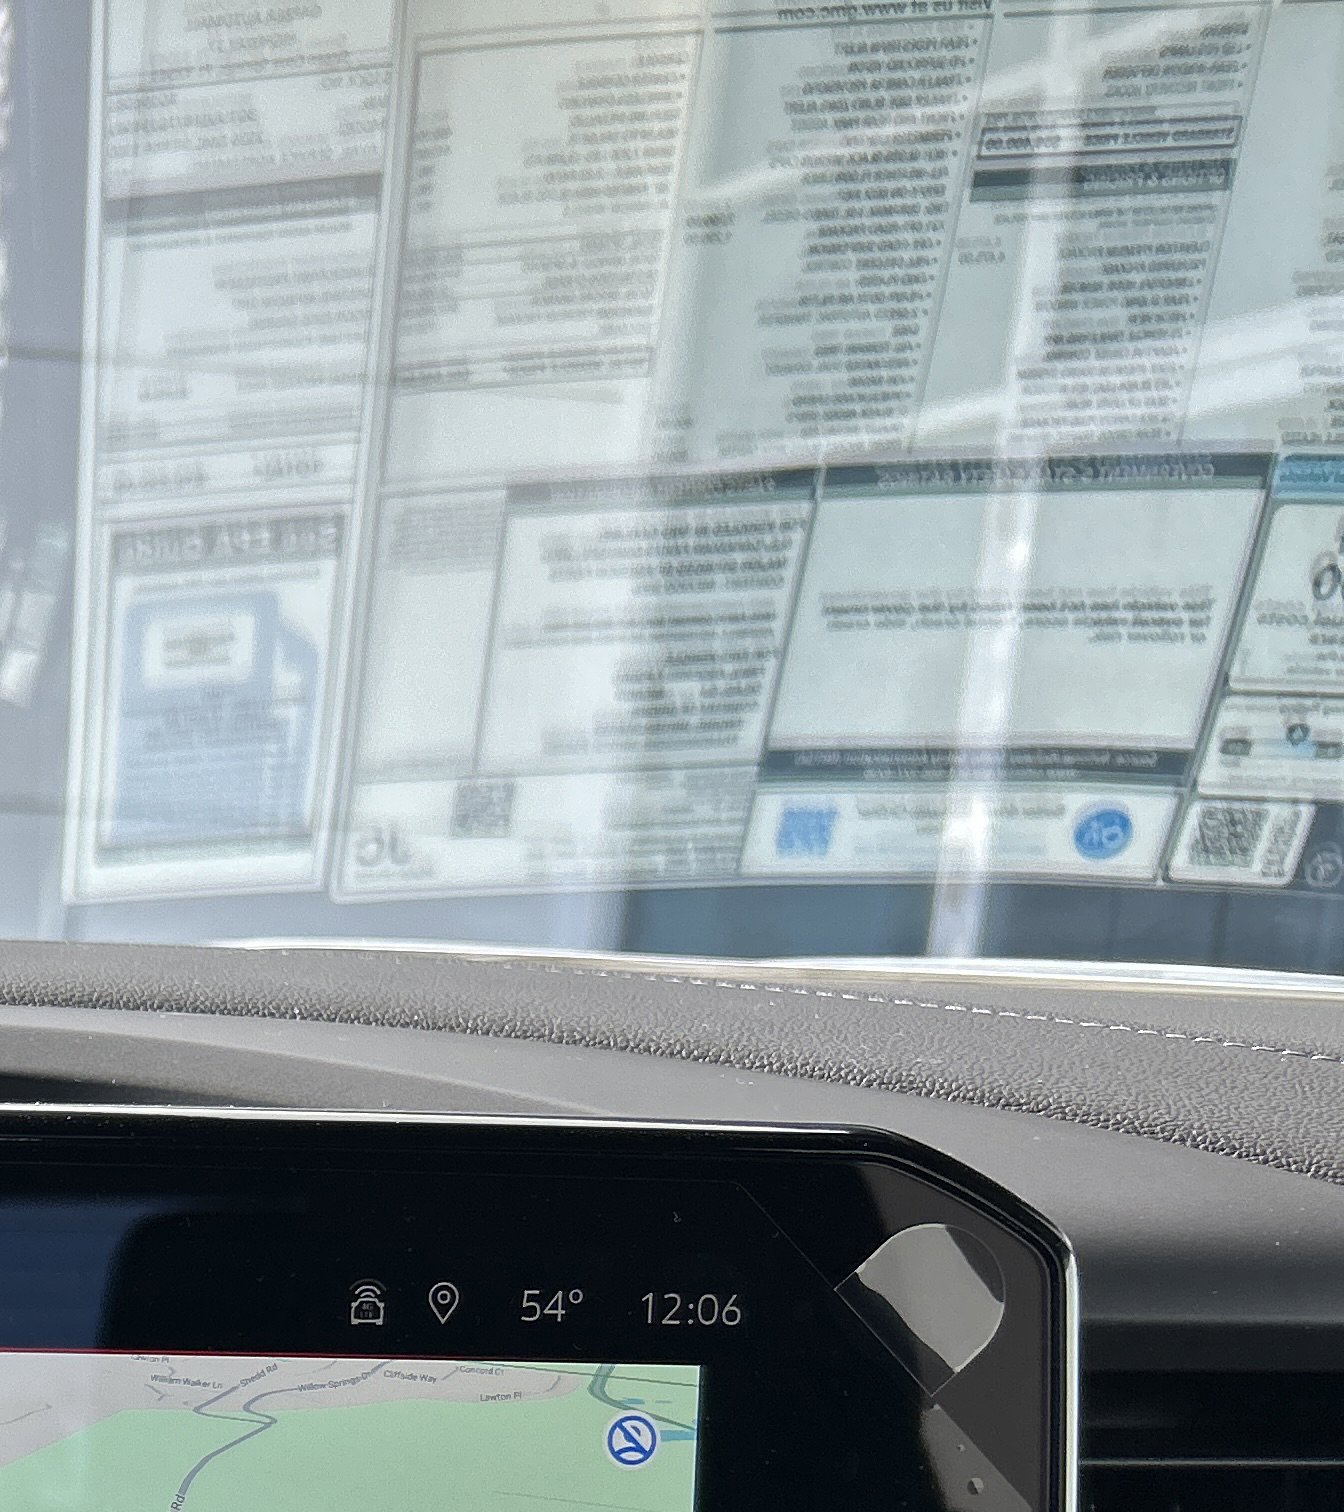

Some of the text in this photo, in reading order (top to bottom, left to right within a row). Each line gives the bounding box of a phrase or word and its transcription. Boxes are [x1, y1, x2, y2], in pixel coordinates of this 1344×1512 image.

[520, 1288, 584, 1323] 54°
[641, 1292, 742, 1326] 12:06
[266, 1362, 278, 1374] Rd
[419, 1374, 437, 1384] Way
[170, 1493, 186, 1512] Rd
